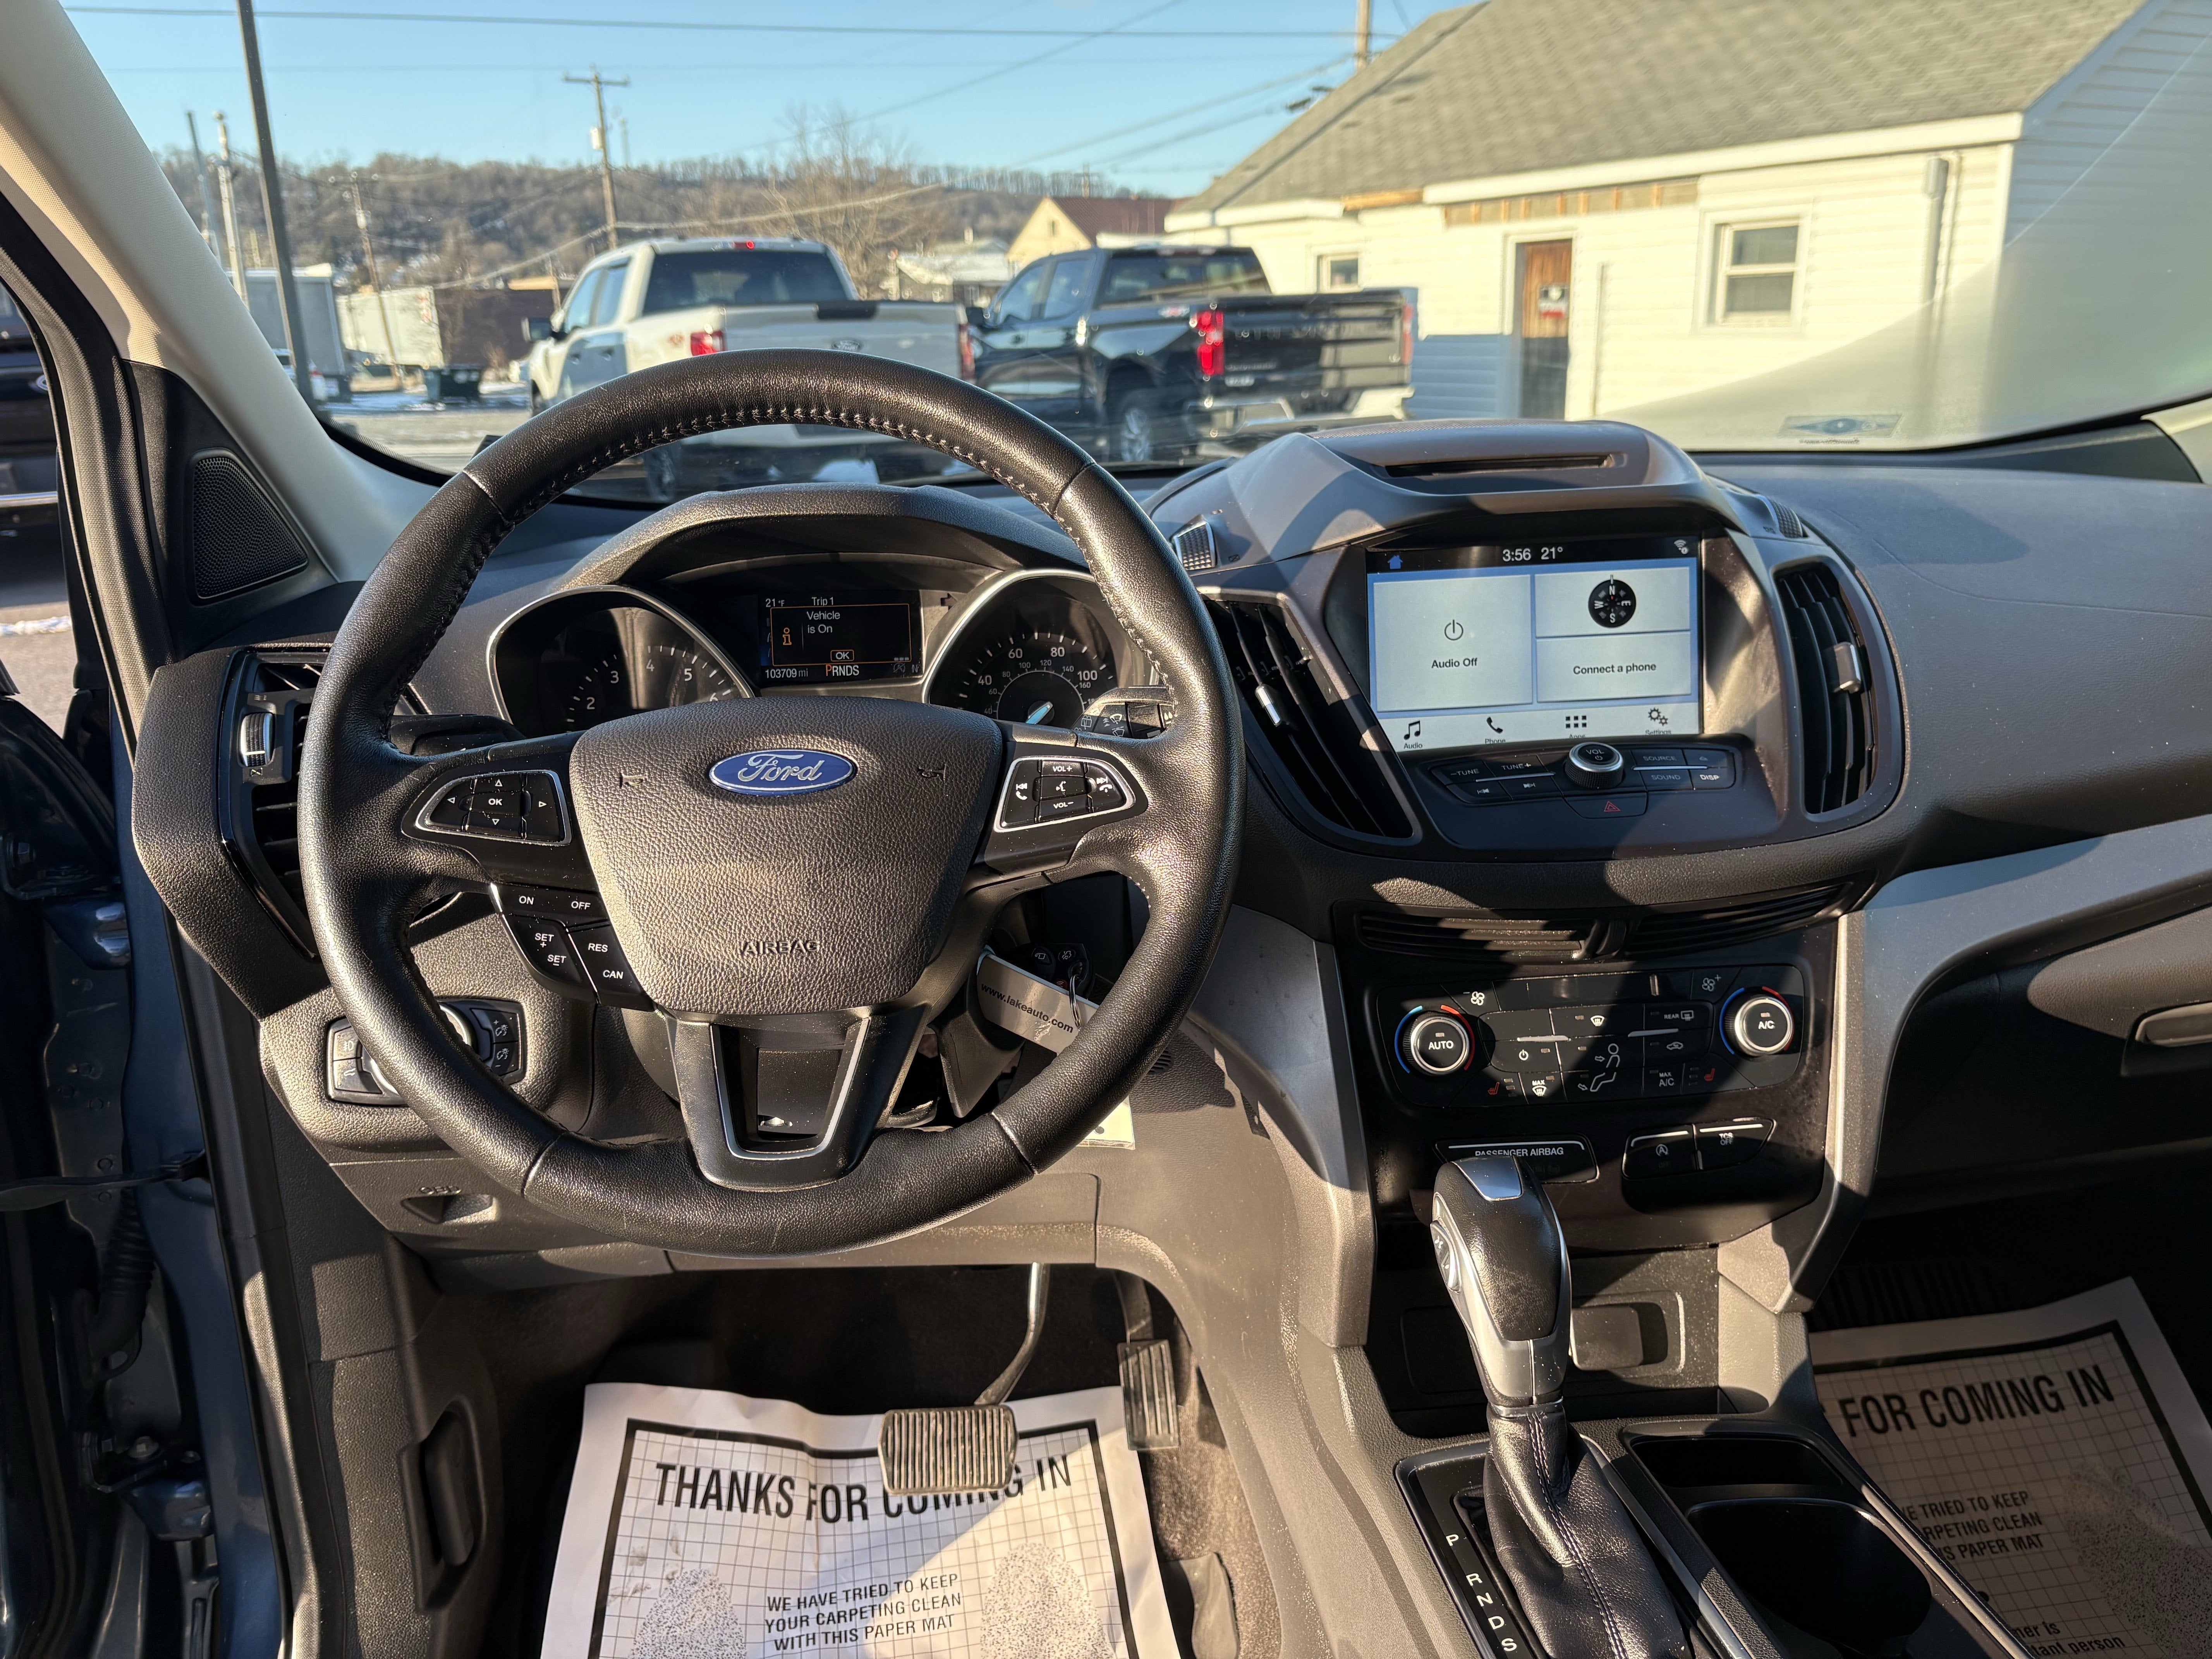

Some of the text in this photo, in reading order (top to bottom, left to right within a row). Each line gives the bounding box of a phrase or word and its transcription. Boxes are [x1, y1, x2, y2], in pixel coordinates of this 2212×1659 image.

[1503, 546, 1563, 562] 3:56 21°
[766, 599, 775, 607] 21
[812, 597, 834, 606] Trip 1
[807, 611, 840, 620] Vehicle
[808, 624, 832, 634] is On
[1008, 648, 1023, 659] 60
[1050, 647, 1065, 657] 80
[646, 659, 655, 672] 4
[1431, 658, 1477, 669] Audio Off
[1573, 665, 1615, 675] Connect
[1626, 663, 1657, 674] phone
[610, 671, 619, 683] 3
[684, 668, 692, 681] 5
[765, 669, 808, 678] 103709 mi
[826, 665, 859, 677] PRNDS
[1077, 670, 1097, 681] 100
[977, 675, 992, 686] 40
[586, 697, 595, 709] 2
[738, 753, 825, 781] Ford
[519, 895, 591, 910] ON OFF
[535, 933, 554, 942] SET
[588, 943, 608, 953] RES
[743, 939, 820, 954] AIRBAG
[547, 954, 567, 963] SET
[603, 969, 623, 979] CAN
[981, 984, 1074, 1034] www.lakeauto.com
[1758, 1020, 1775, 1030] A/C
[1428, 1041, 1454, 1050] AUTO
[1659, 1078, 1674, 1087] A/C
[1530, 1147, 1564, 1156] AIRBAG
[1838, 1364, 2114, 1437] FOR COMING IN
[656, 1462, 795, 1518] THANKS
[806, 1483, 869, 1523] FOR
[1037, 1455, 1072, 1491] IN
[1919, 1499, 1965, 1519] TRIED
[1967, 1496, 1989, 1511] TO
[1991, 1491, 2029, 1510] KEEP
[1992, 1511, 2043, 1532] CLEAN
[1446, 1534, 1459, 1546] P
[1958, 1538, 2009, 1559] PAPER
[2011, 1533, 2044, 1549] MAT
[1466, 1573, 1483, 1586] R
[767, 1573, 958, 1612] WE HAVE TRIED TO KEEP
[1476, 1592, 1494, 1607] N
[764, 1592, 961, 1633] YOUR CARPETING CLEAN
[1488, 1616, 1504, 1630] D
[2042, 1621, 2061, 1635] is
[775, 1613, 955, 1651] WITH THIS PAPER MAT
[1501, 1638, 1517, 1652] S
[2068, 1637, 2126, 1655] person
